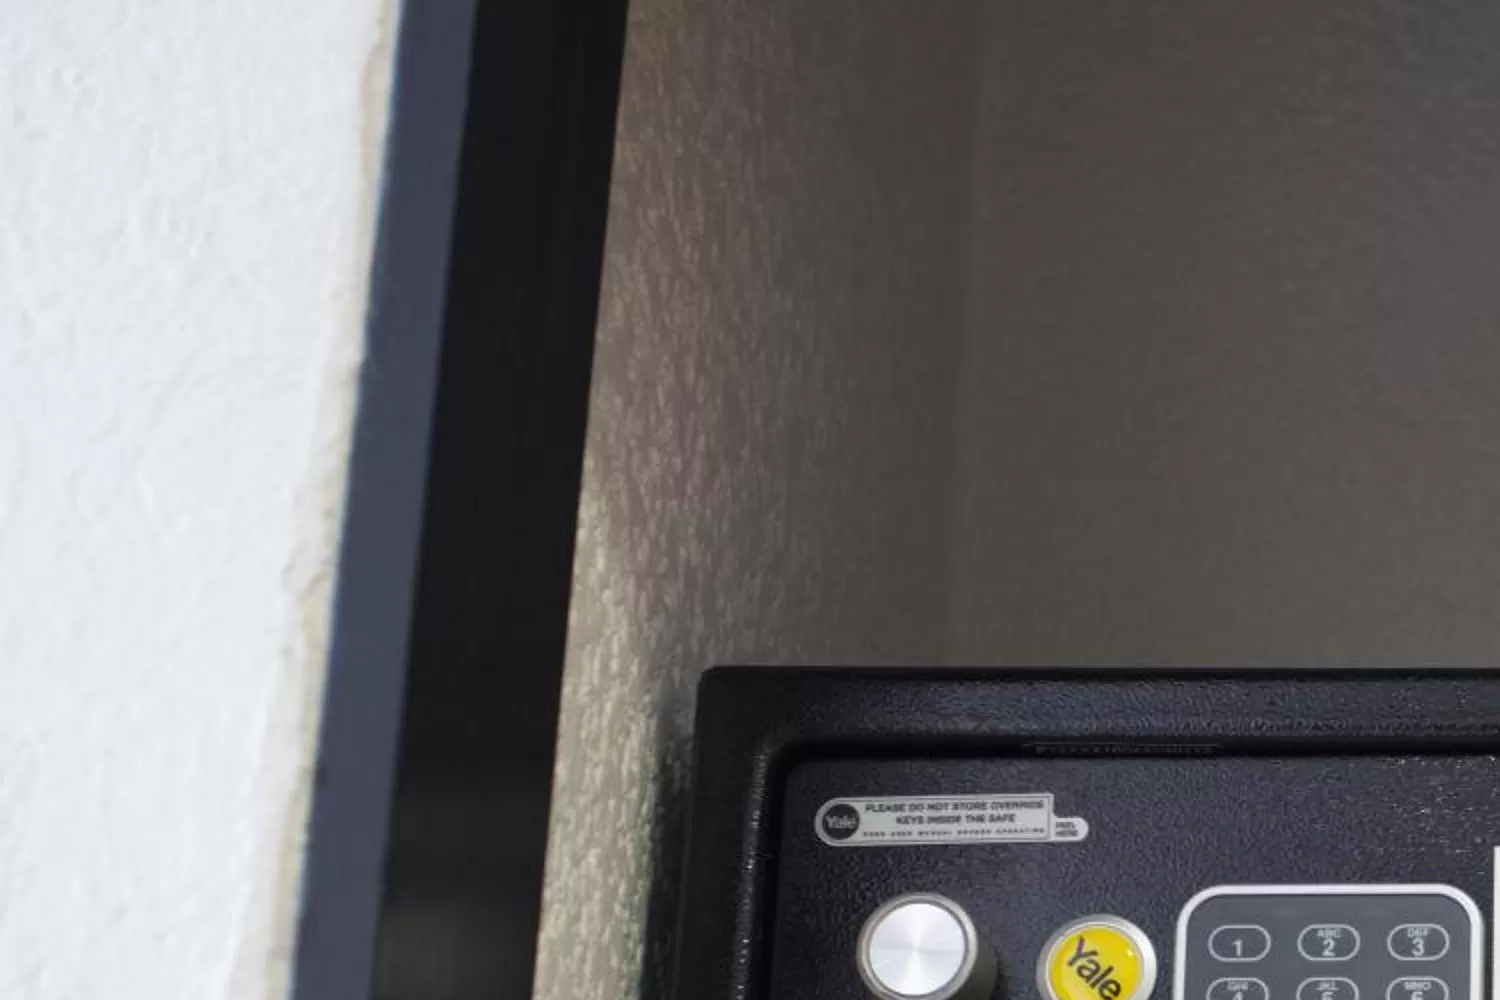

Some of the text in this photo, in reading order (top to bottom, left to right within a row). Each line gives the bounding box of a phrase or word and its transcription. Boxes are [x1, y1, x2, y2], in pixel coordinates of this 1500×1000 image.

[865, 803, 905, 812] PLEASE
[909, 803, 924, 812] DO
[927, 802, 948, 811] NOT
[951, 801, 987, 810] STORE
[825, 815, 857, 829] Yale
[896, 815, 924, 824] KEYS
[965, 814, 985, 823] THE
[988, 813, 1016, 823] SAFE
[1232, 939, 1243, 957] 1
[1322, 938, 1336, 957] 2
[1411, 937, 1425, 956] 3
[1067, 935, 1121, 1000] Yale
